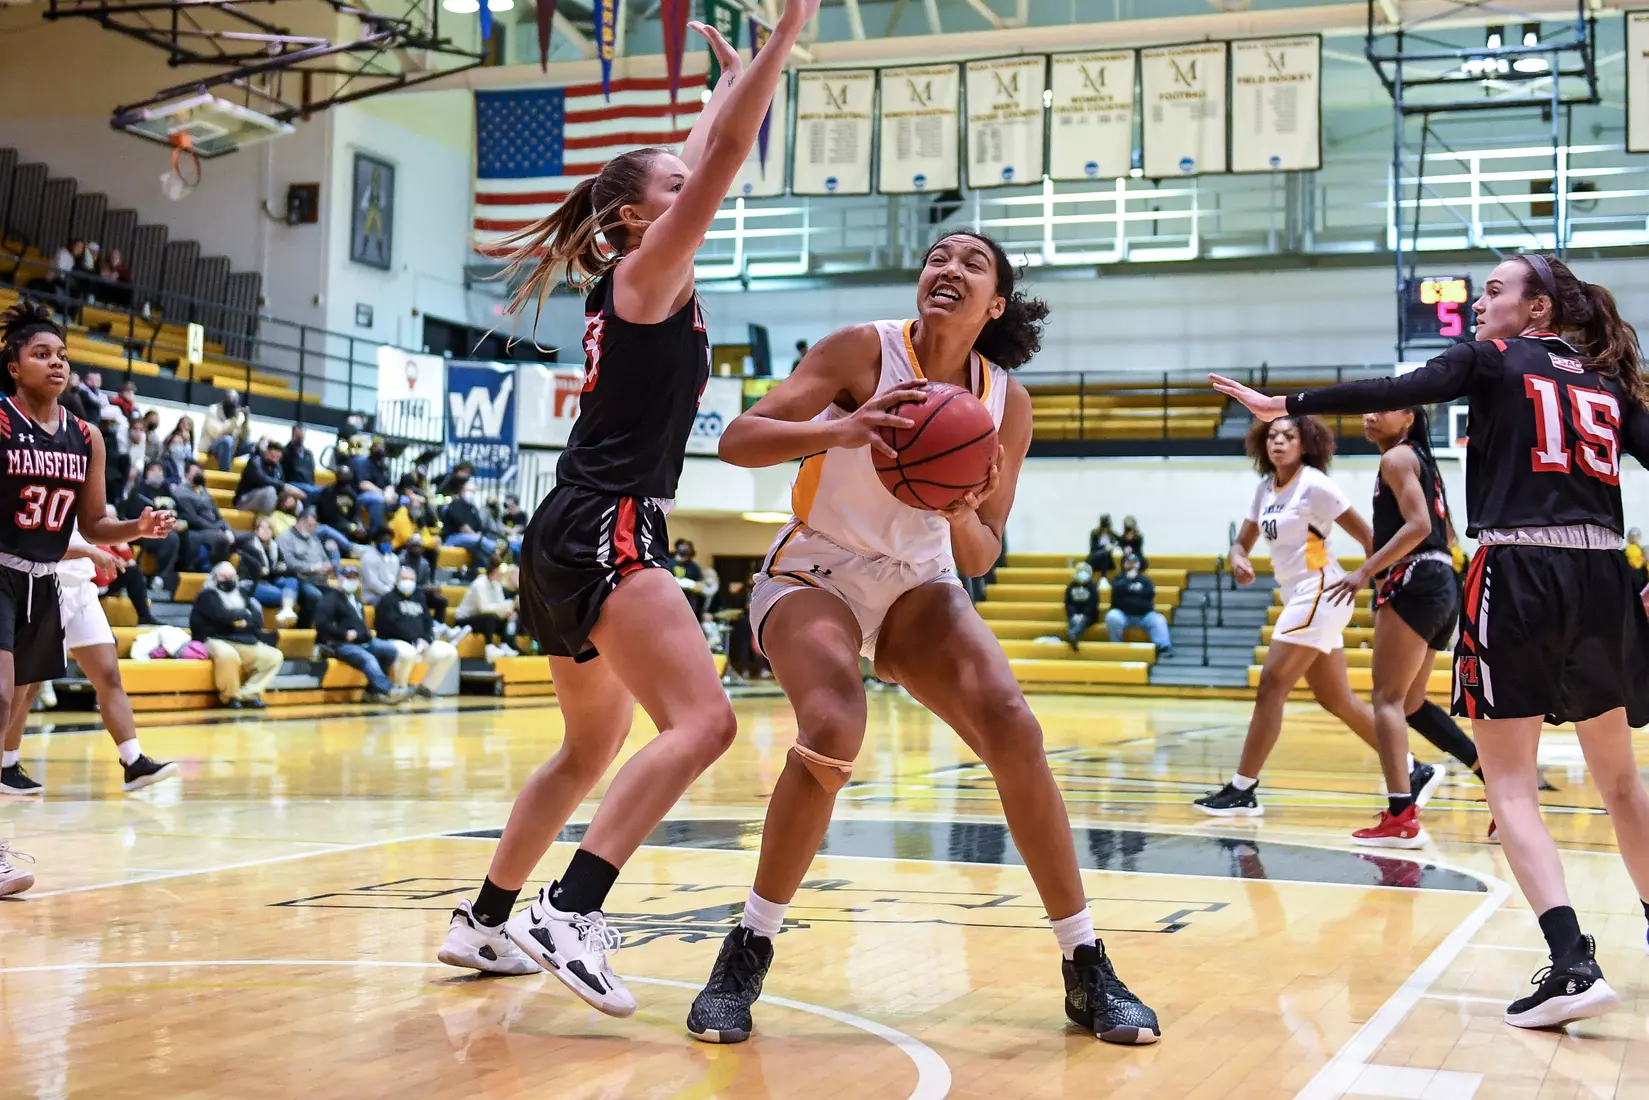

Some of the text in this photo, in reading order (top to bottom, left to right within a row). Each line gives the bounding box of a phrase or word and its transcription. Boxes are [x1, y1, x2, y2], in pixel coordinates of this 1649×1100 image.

[1437, 301, 1462, 337] 5
[1523, 373, 1622, 487] 15
[6, 448, 87, 483] MANSFIEL
[14, 484, 76, 532] 30
